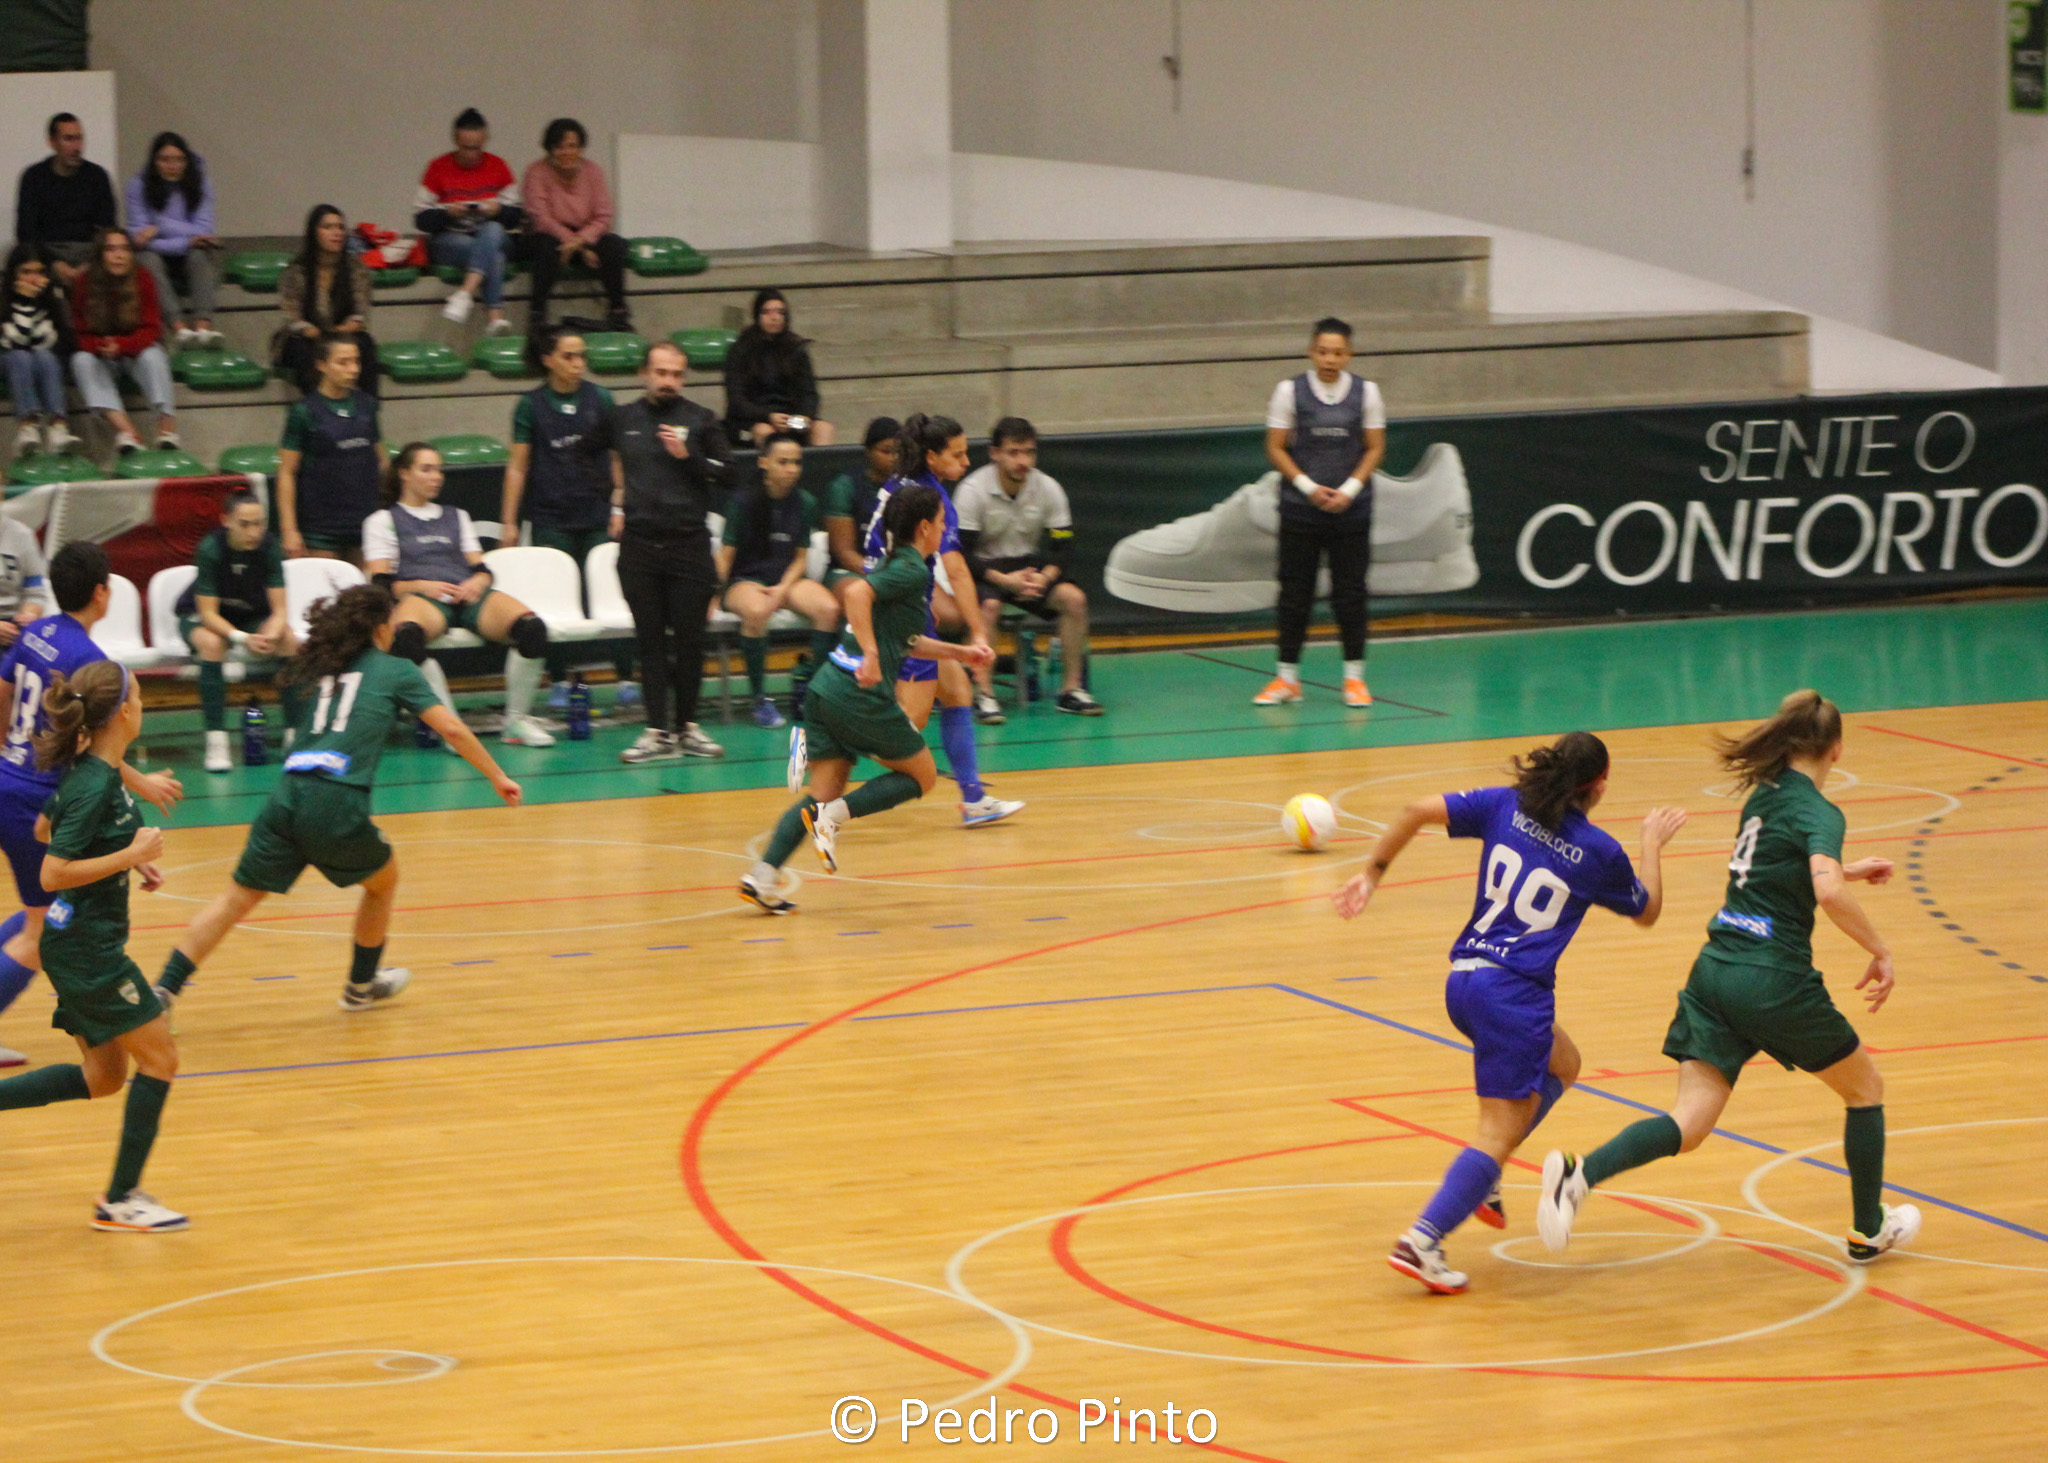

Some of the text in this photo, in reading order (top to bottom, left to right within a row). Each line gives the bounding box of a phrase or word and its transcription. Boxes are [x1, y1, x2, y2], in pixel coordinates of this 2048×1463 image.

[1700, 410, 1976, 484] SENTE O
[1515, 483, 2047, 589] CONFORTO
[8, 661, 43, 745] 13
[310, 671, 363, 734] 11
[1473, 843, 1571, 943] 99
